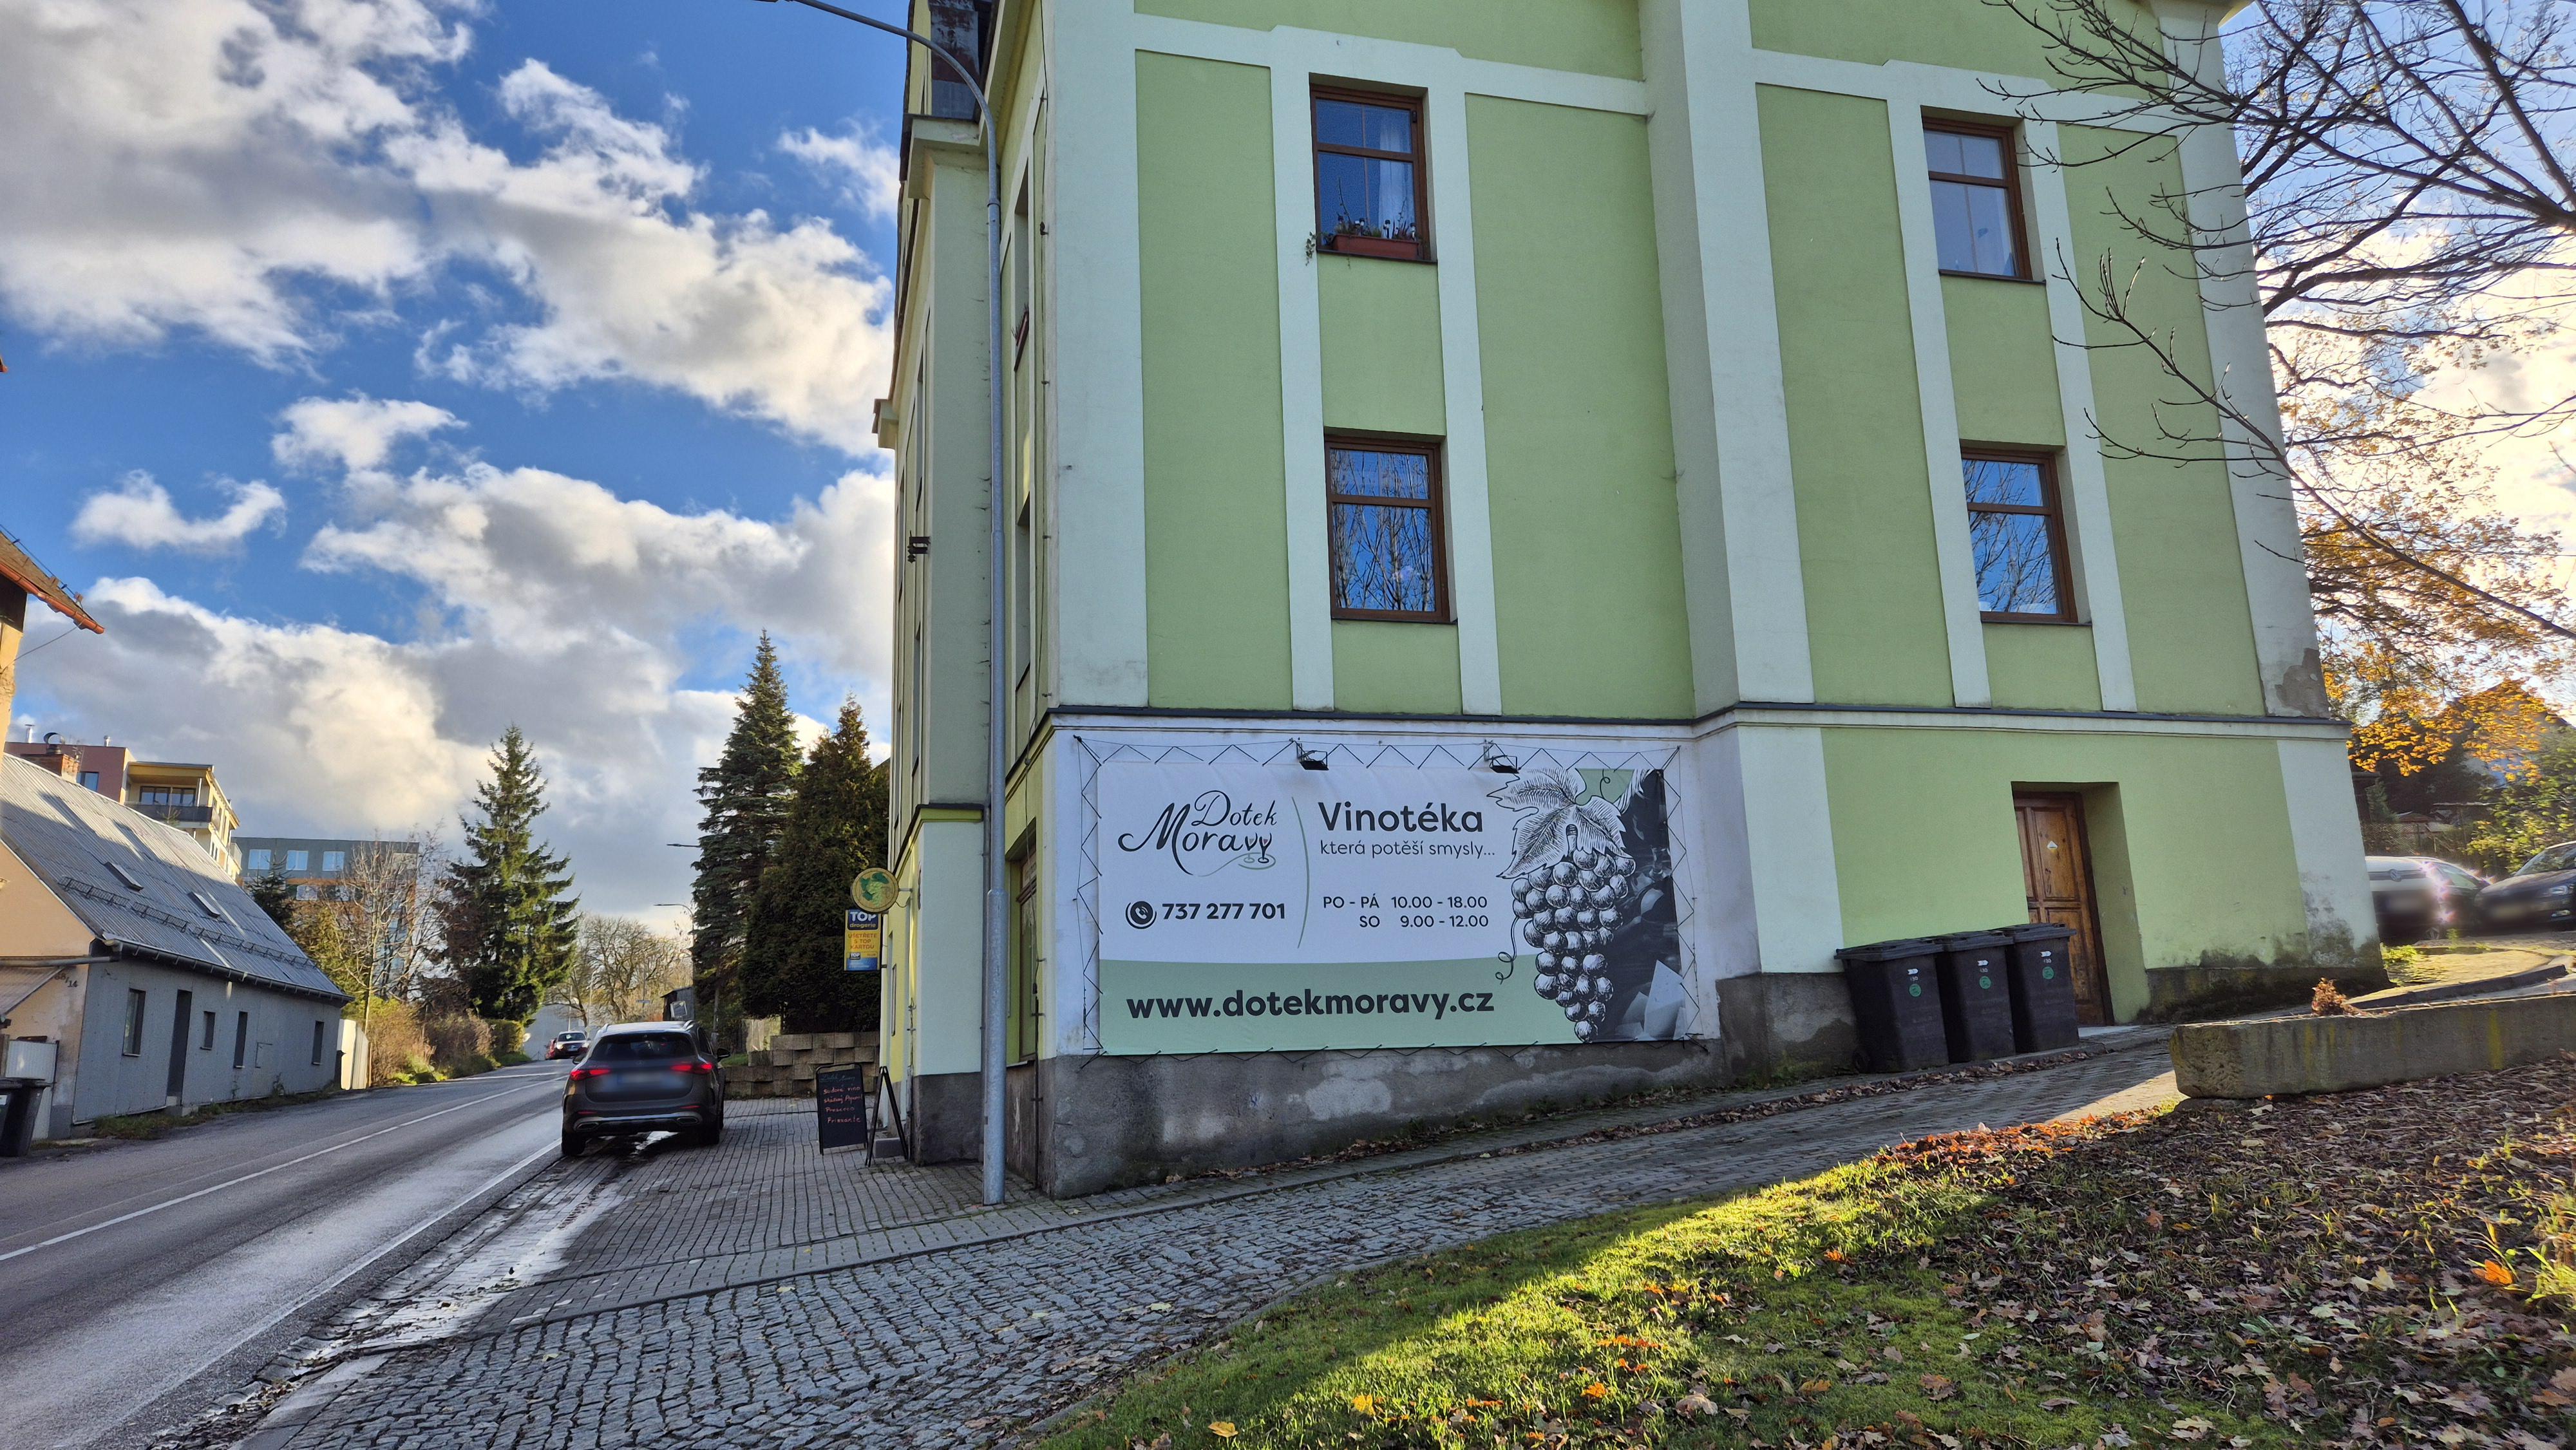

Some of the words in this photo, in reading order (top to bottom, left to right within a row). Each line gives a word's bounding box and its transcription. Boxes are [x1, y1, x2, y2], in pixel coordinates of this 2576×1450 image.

[1191, 790, 1278, 827] Dotek
[1318, 800, 1483, 833] Vinotéka
[1117, 802, 1273, 876] Moravy
[1320, 840, 1365, 855] která
[1372, 840, 1425, 859] potěší
[1428, 841, 1495, 860] smysly...
[1161, 903, 1201, 920] 737
[1206, 903, 1245, 920] 277
[1249, 903, 1285, 920] 701
[1323, 896, 1345, 909] PO
[1360, 893, 1380, 909] PÁ
[1391, 896, 1432, 909] 10.00
[1447, 896, 1488, 909] 18.00
[1359, 915, 1381, 928] SO
[1399, 915, 1435, 928] 9.00
[1448, 914, 1490, 927] 12.00
[1126, 988, 1495, 1020] www.dotekmoravy.cz
